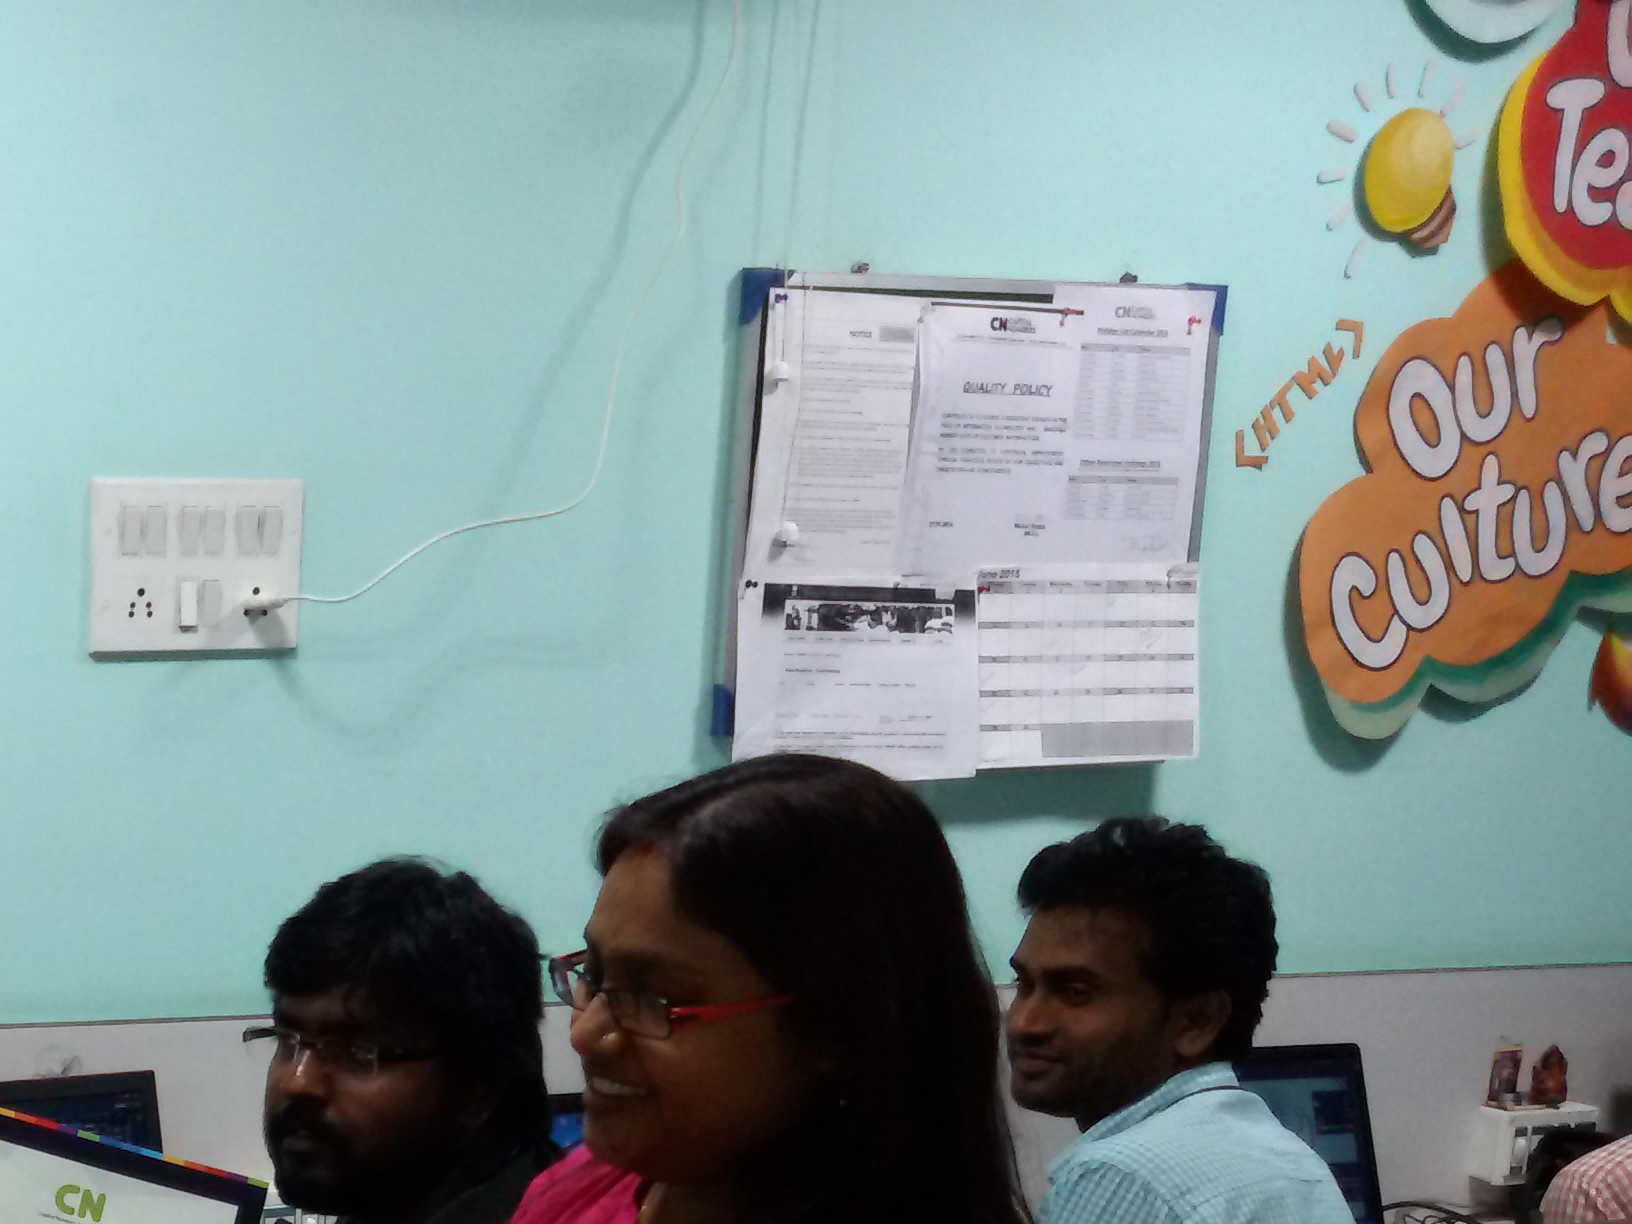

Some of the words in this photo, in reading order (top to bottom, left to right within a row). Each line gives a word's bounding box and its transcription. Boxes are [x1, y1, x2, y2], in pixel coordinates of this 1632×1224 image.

[962, 380, 1007, 395] QUALITY
[1012, 382, 1053, 397] POLICY
[1387, 316, 1563, 479] Our
[54, 1184, 107, 1223] CN
